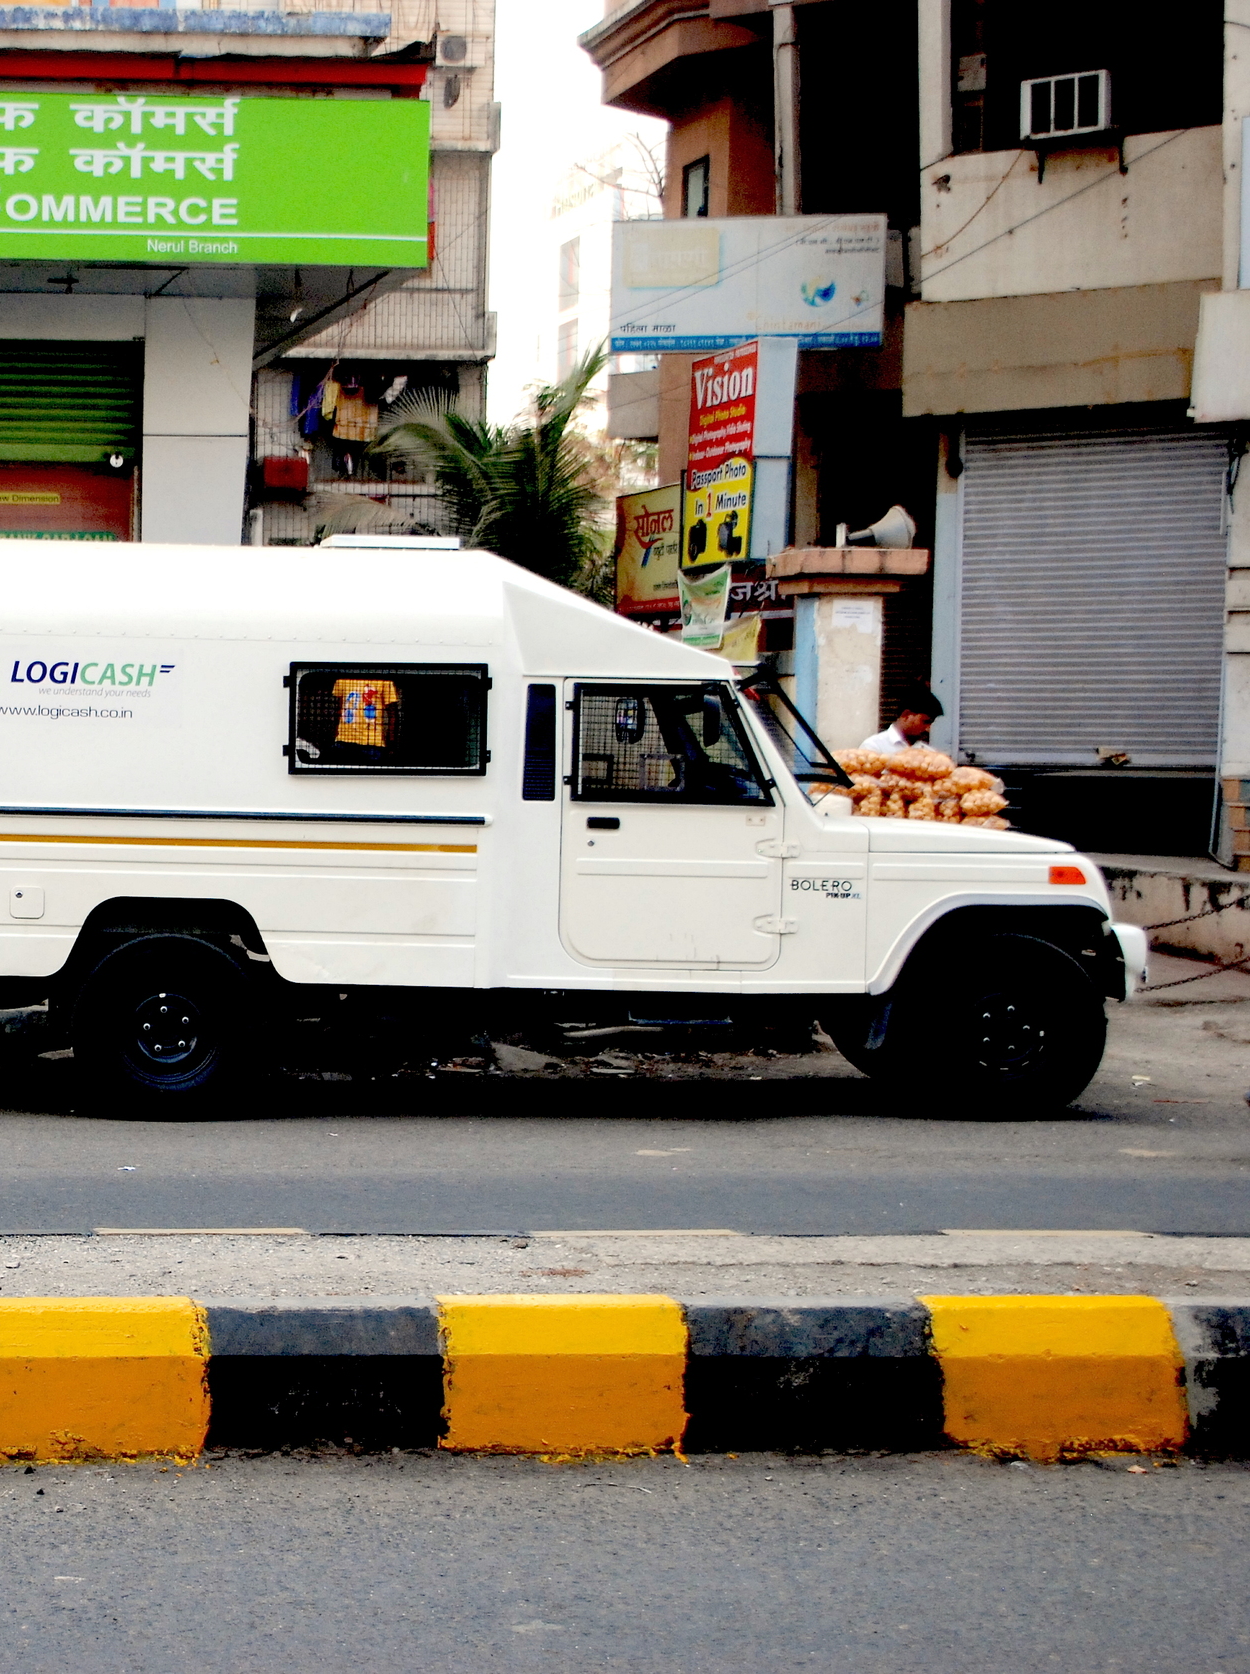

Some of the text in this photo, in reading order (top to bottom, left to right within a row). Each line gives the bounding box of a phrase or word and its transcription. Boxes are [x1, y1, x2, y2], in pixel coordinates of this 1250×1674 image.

[69, 95, 240, 137] कॉमर्स
[69, 142, 240, 181] कॉमर्स
[147, 238, 238, 255] Nerul Branch
[694, 362, 754, 410] Vision
[691, 463, 747, 490] Passport Photo
[12, 495, 60, 503] Dimension
[695, 492, 747, 518] In 1 Minute
[633, 504, 674, 539] सोनल
[10, 660, 157, 687] LOGICASH
[53, 687, 103, 697] understand
[104, 688, 124, 699] your
[125, 689, 151, 698] needs
[790, 880, 852, 892] BOLERO
